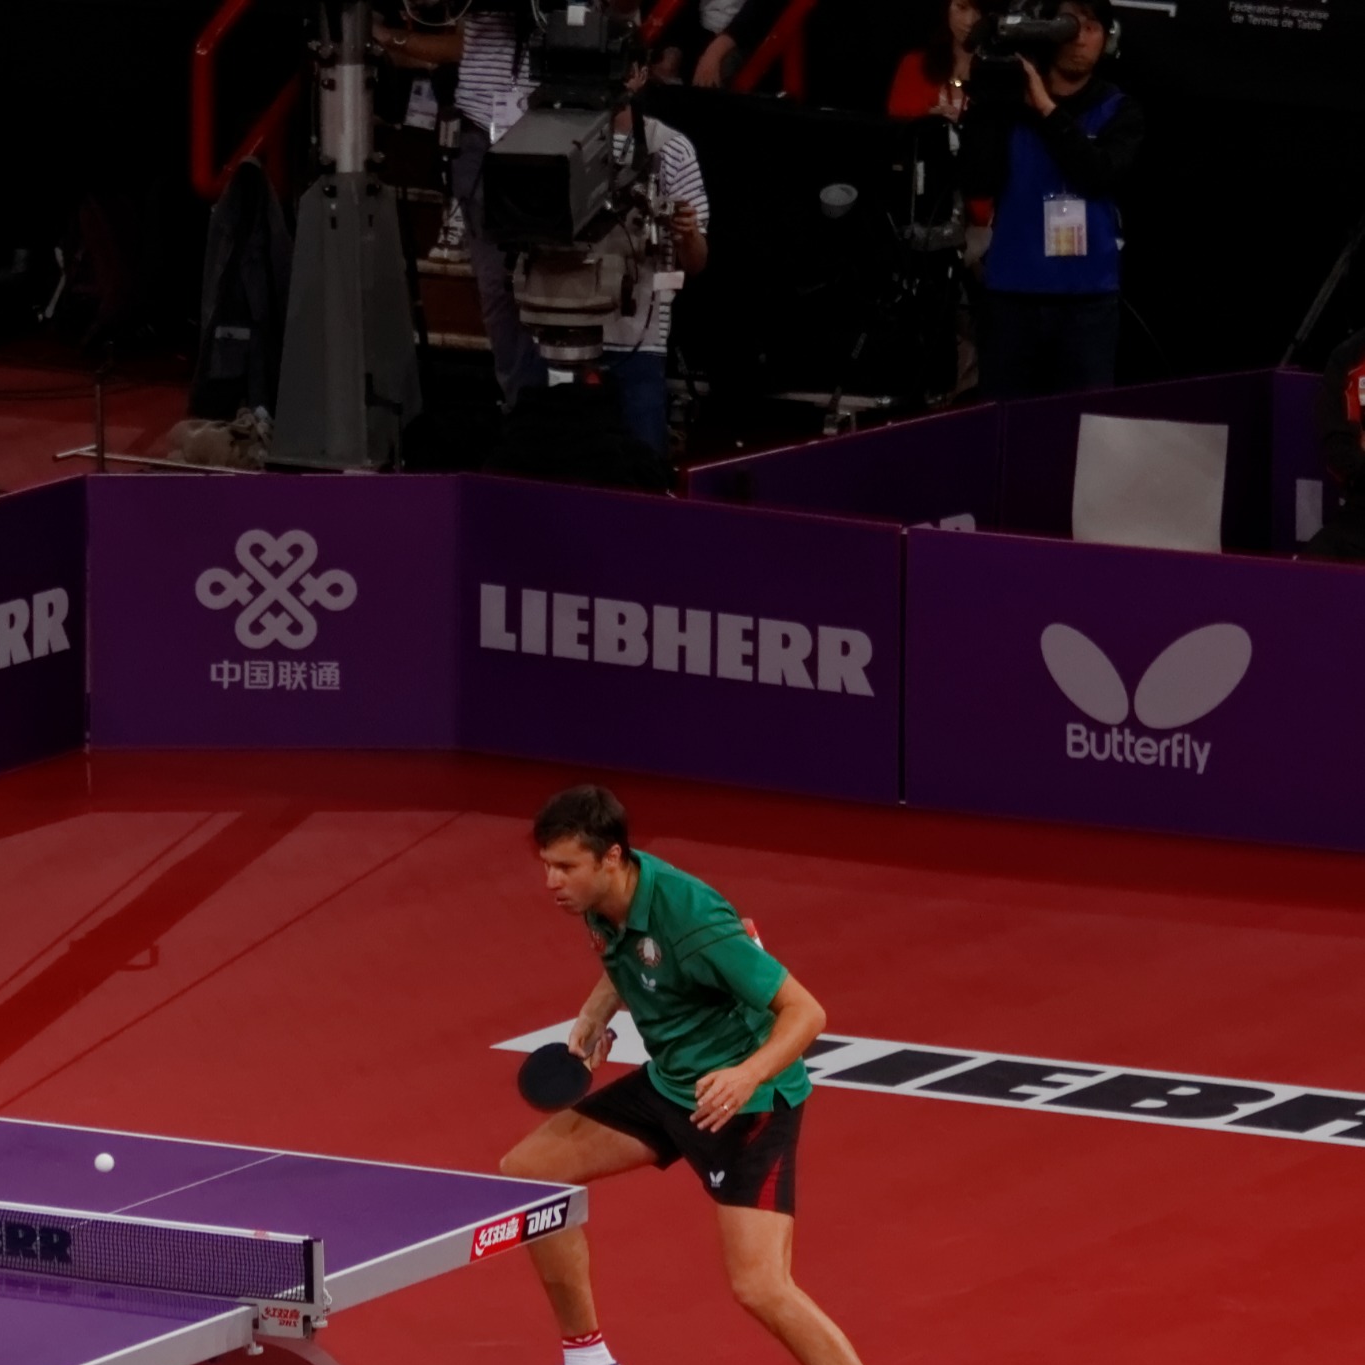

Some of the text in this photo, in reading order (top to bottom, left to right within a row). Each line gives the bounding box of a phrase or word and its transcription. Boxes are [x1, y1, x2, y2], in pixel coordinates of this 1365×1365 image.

[479, 582, 875, 697] LIEBHERR
[209, 660, 341, 691] 中国联通
[1066, 722, 1212, 775] Butterfly
[526, 1201, 567, 1236] DHS
